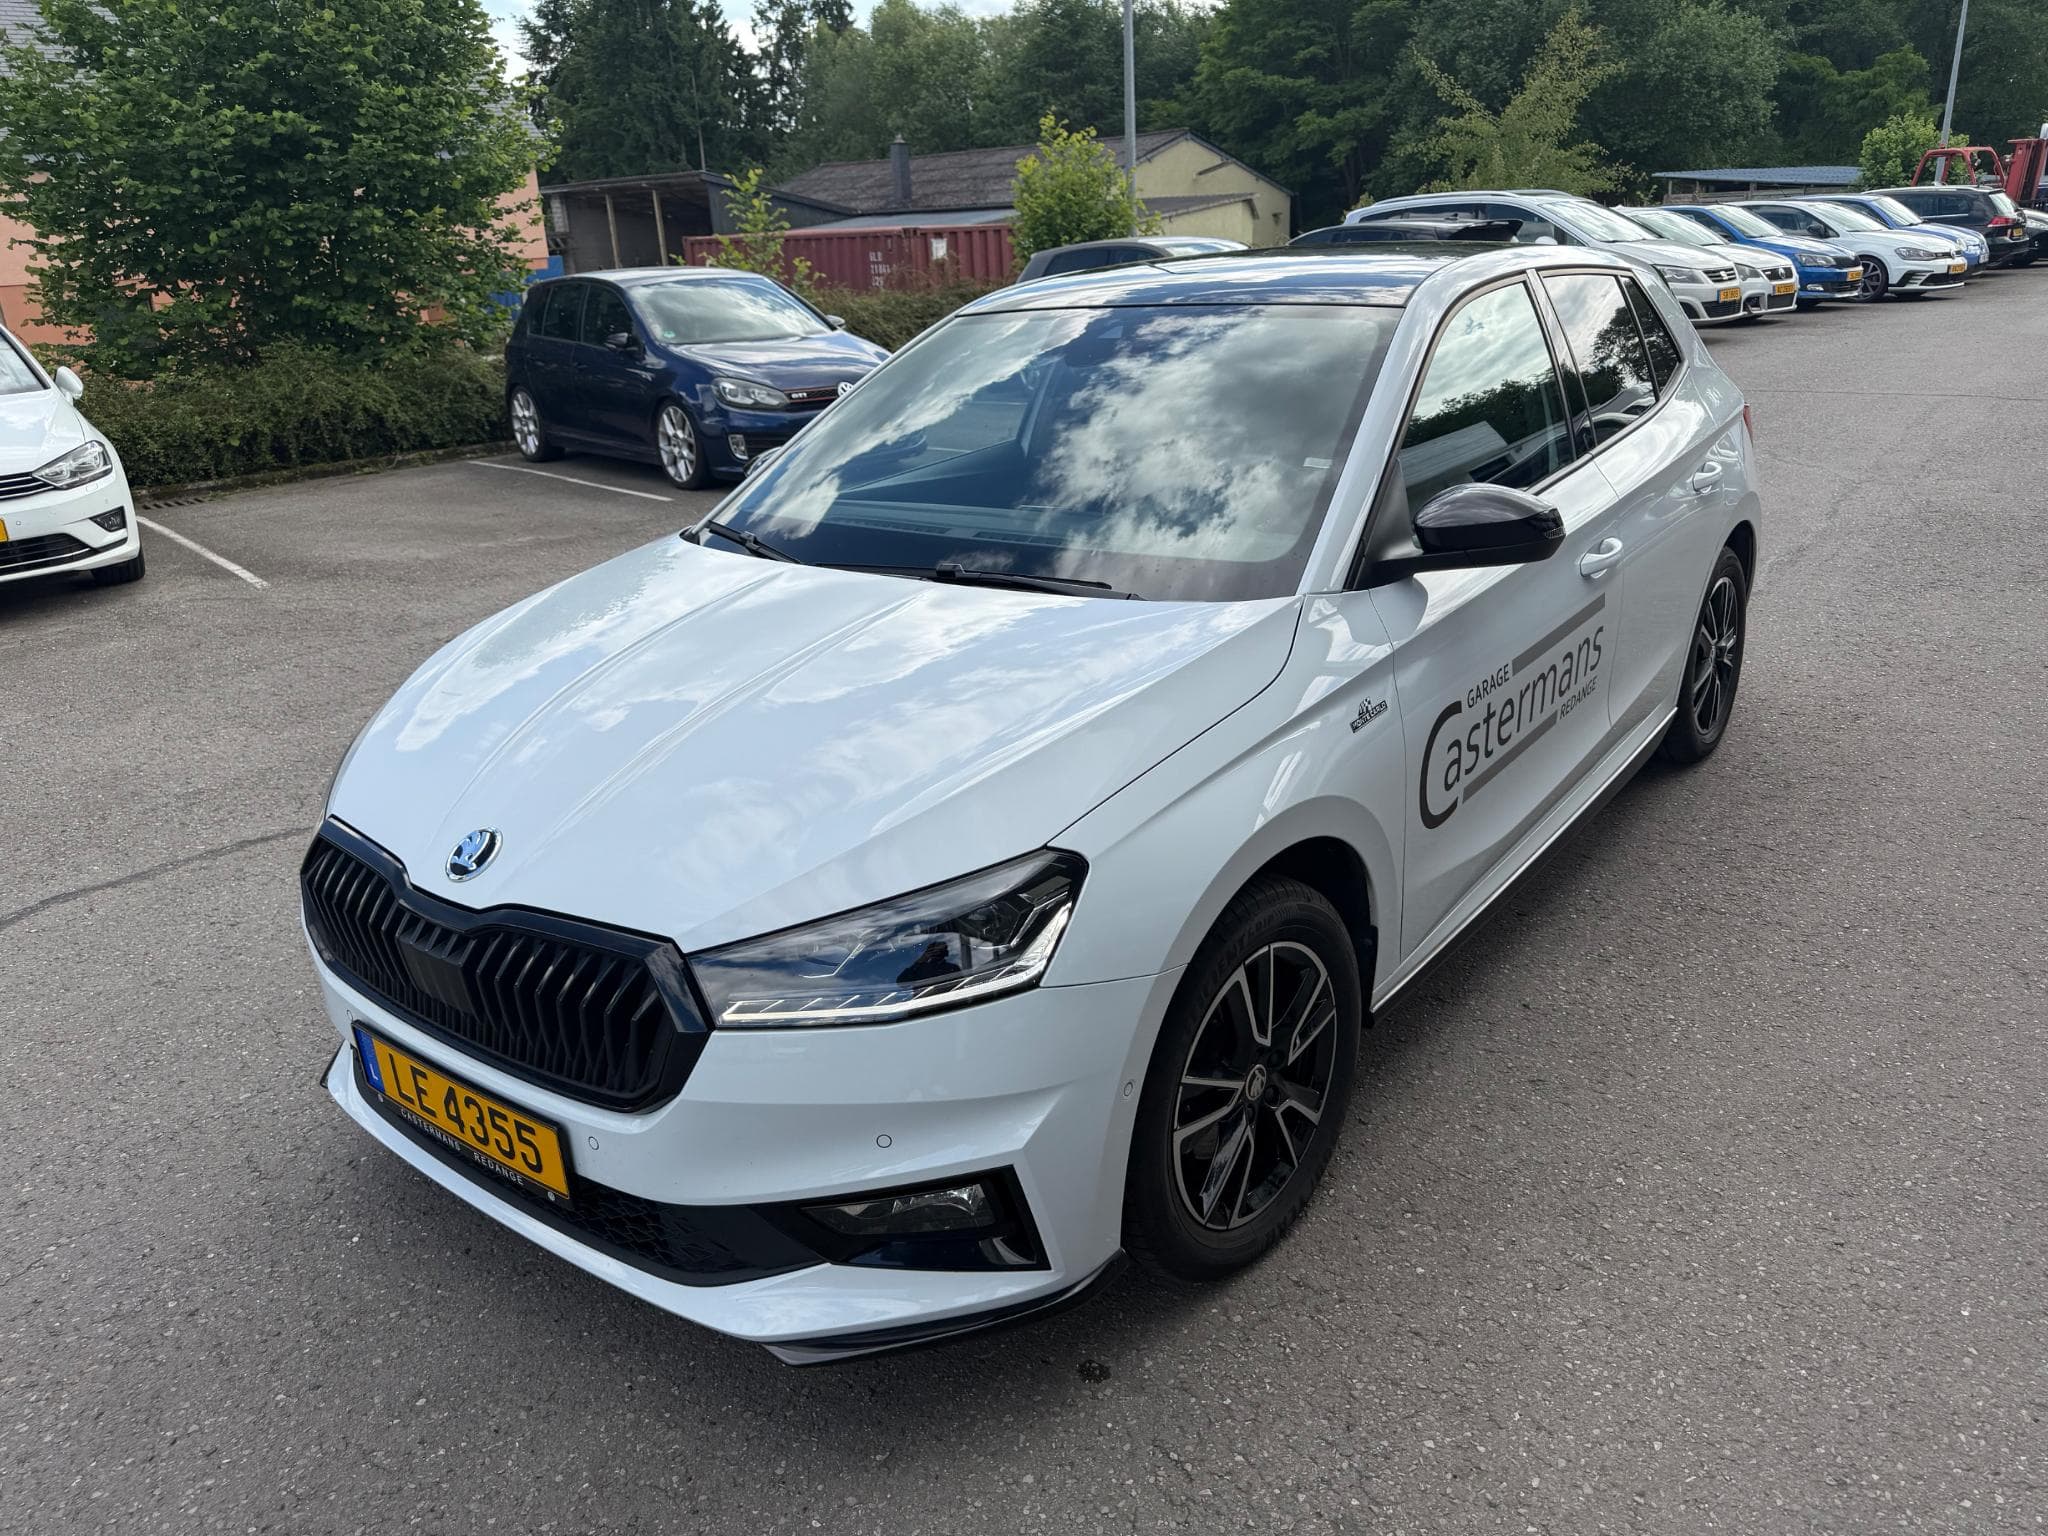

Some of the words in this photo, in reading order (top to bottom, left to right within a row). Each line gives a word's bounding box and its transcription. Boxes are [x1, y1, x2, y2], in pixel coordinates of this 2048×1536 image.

[1467, 663, 1510, 709] GARAGE
[1559, 675, 1600, 720] REDANGE
[1420, 626, 1604, 829] Castermans
[370, 1063, 379, 1081] L
[389, 1053, 437, 1118] LE
[443, 1085, 543, 1174] 4355
[473, 1151, 524, 1186] REDANGE
